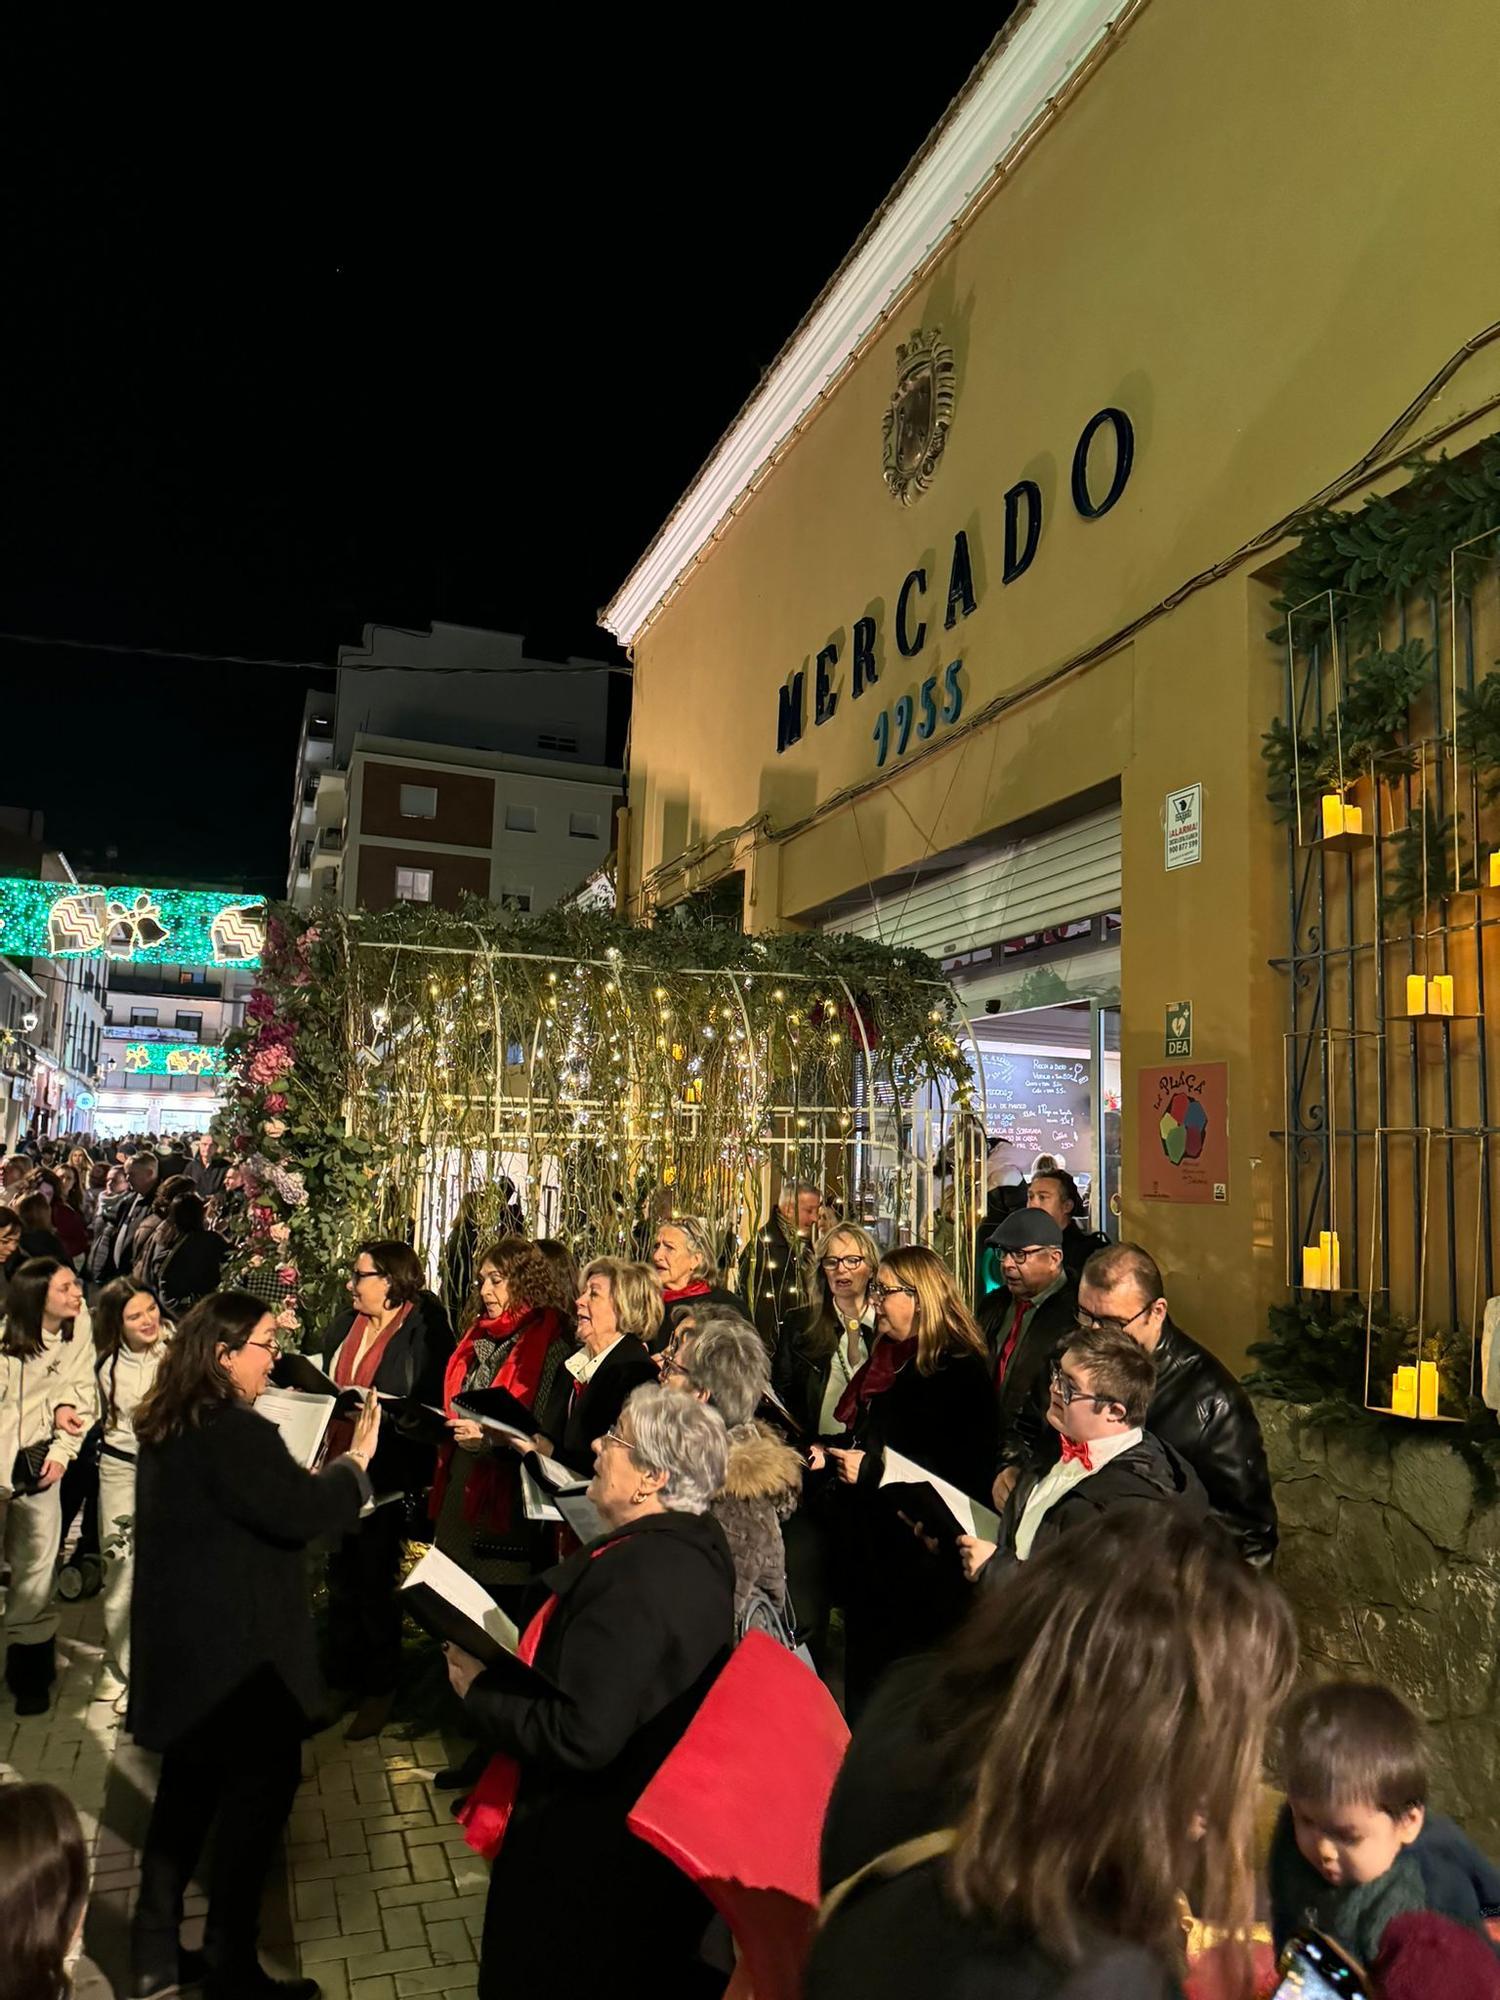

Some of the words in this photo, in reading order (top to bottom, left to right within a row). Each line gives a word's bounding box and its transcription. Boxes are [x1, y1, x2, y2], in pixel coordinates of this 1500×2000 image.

[776, 407, 1135, 754] MERCADO
[872, 659, 964, 767] 1955
[1168, 1040, 1189, 1055] DEA
[1159, 1070, 1206, 1096] PLAÇA
